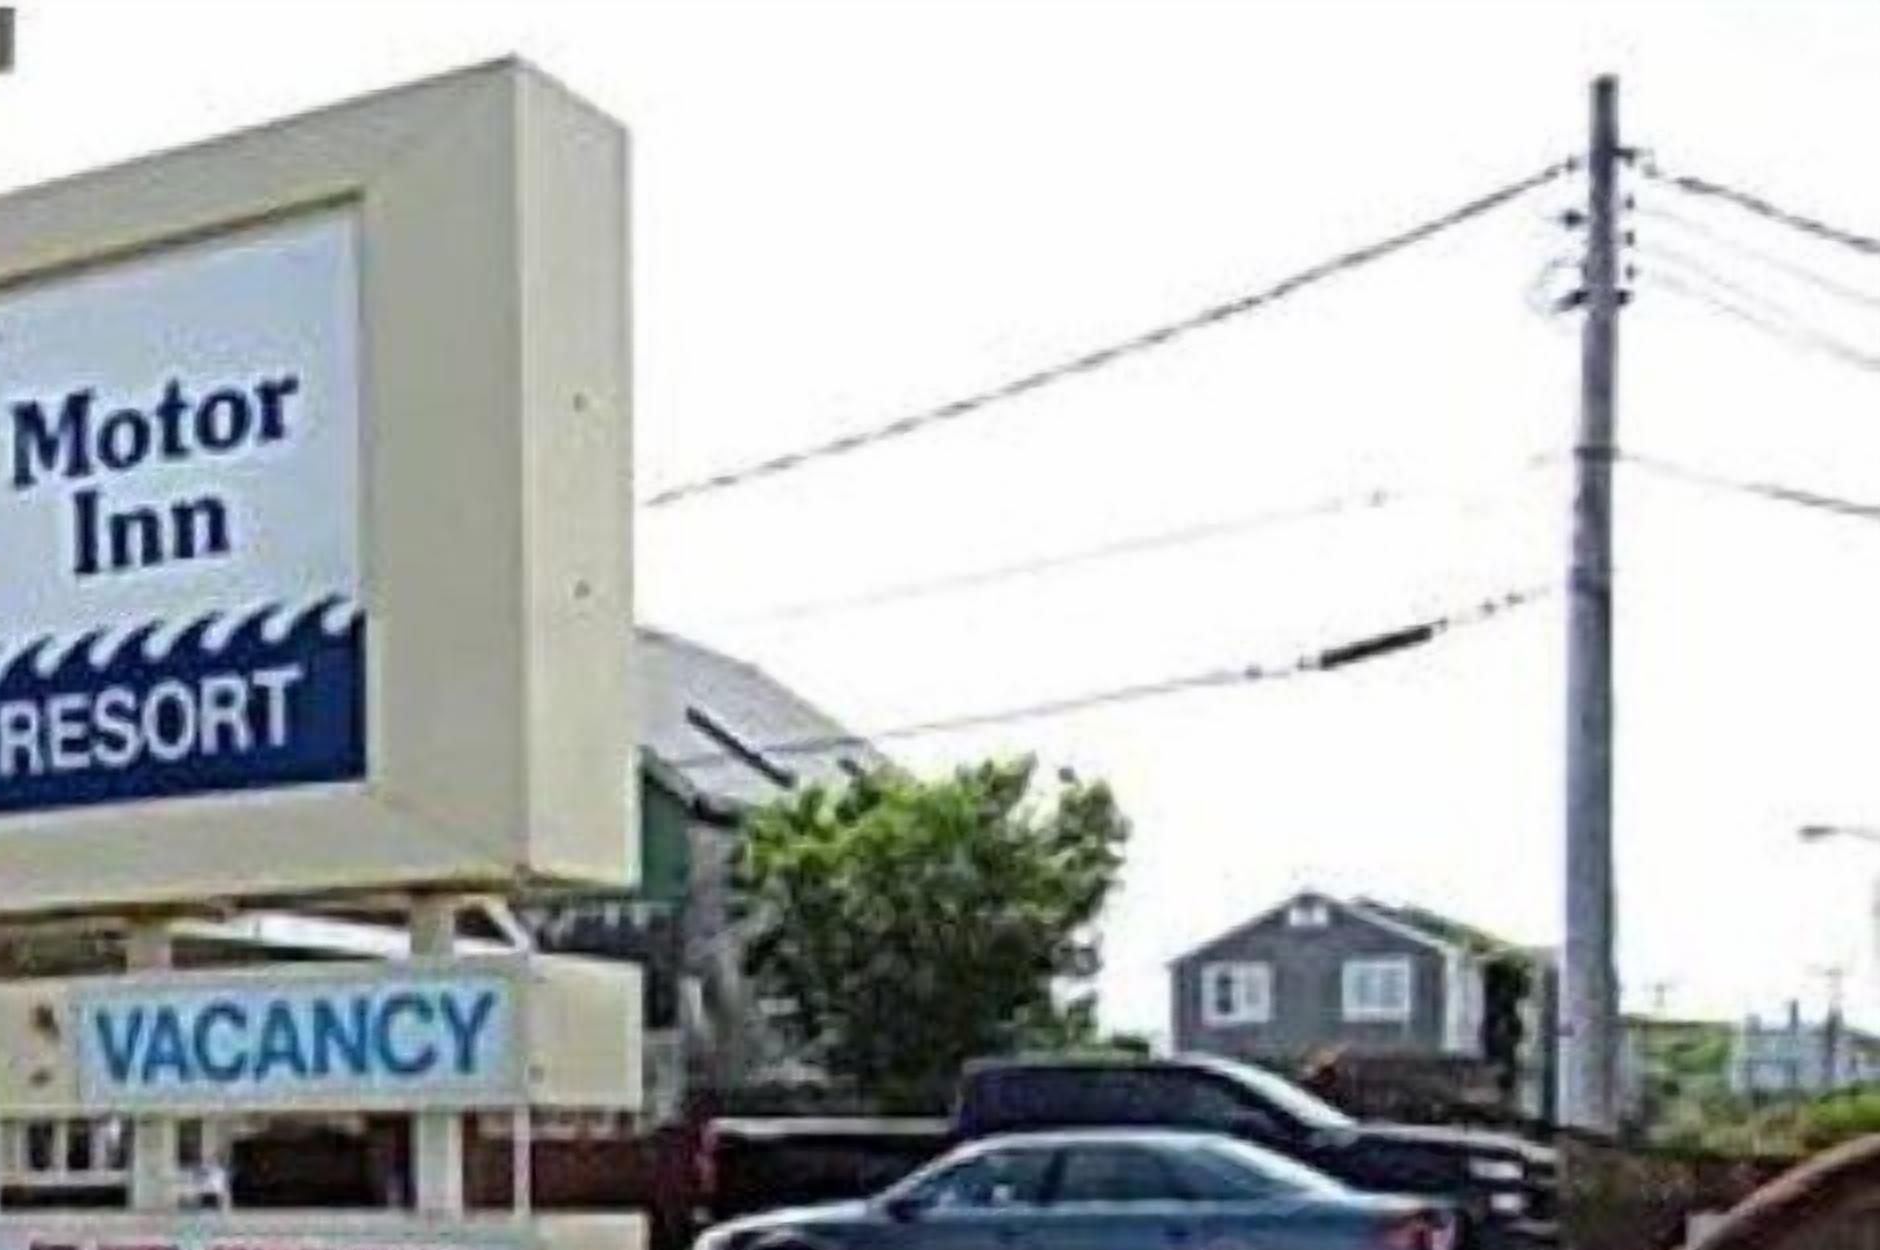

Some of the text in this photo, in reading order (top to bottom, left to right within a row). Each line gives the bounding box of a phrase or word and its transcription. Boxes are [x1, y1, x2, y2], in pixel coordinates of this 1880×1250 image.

[11, 374, 300, 489] Motor
[71, 487, 232, 577] Inn
[0, 667, 303, 779] RESORT
[96, 991, 496, 1083] VACANCY
